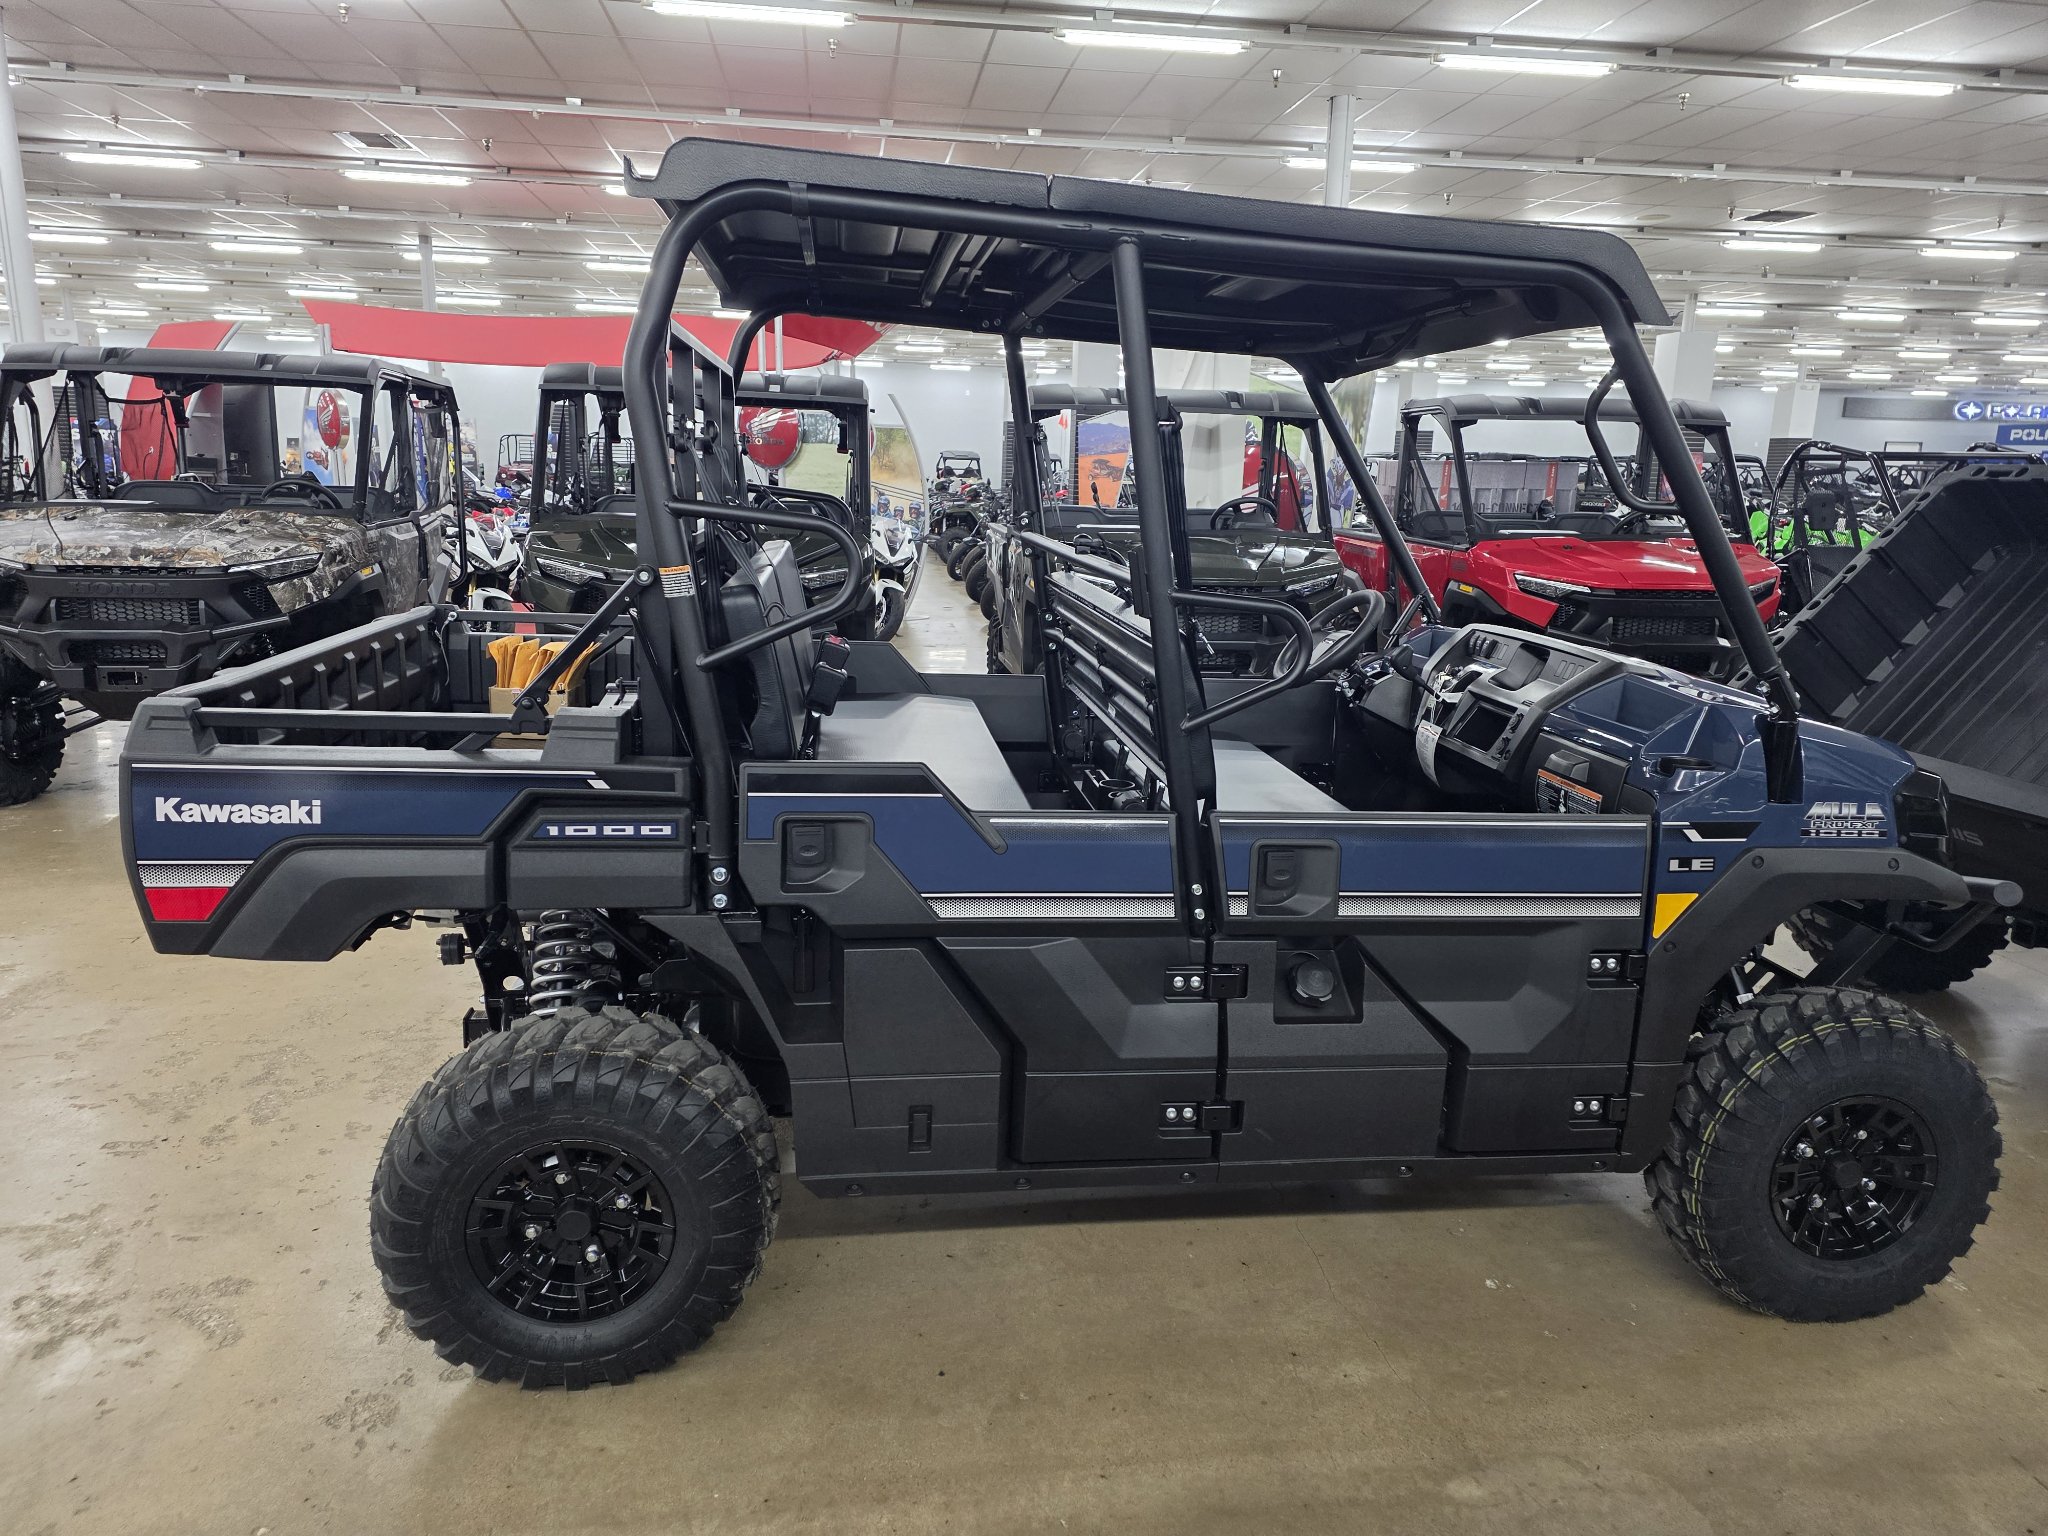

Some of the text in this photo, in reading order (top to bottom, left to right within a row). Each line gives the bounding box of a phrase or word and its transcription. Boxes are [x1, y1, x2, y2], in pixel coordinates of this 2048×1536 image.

[155, 796, 322, 825] Kawasaki
[1803, 801, 1887, 821] MULE
[546, 825, 672, 836] 1000
[1809, 829, 1880, 837] 1000
[1669, 858, 1714, 872] LE
